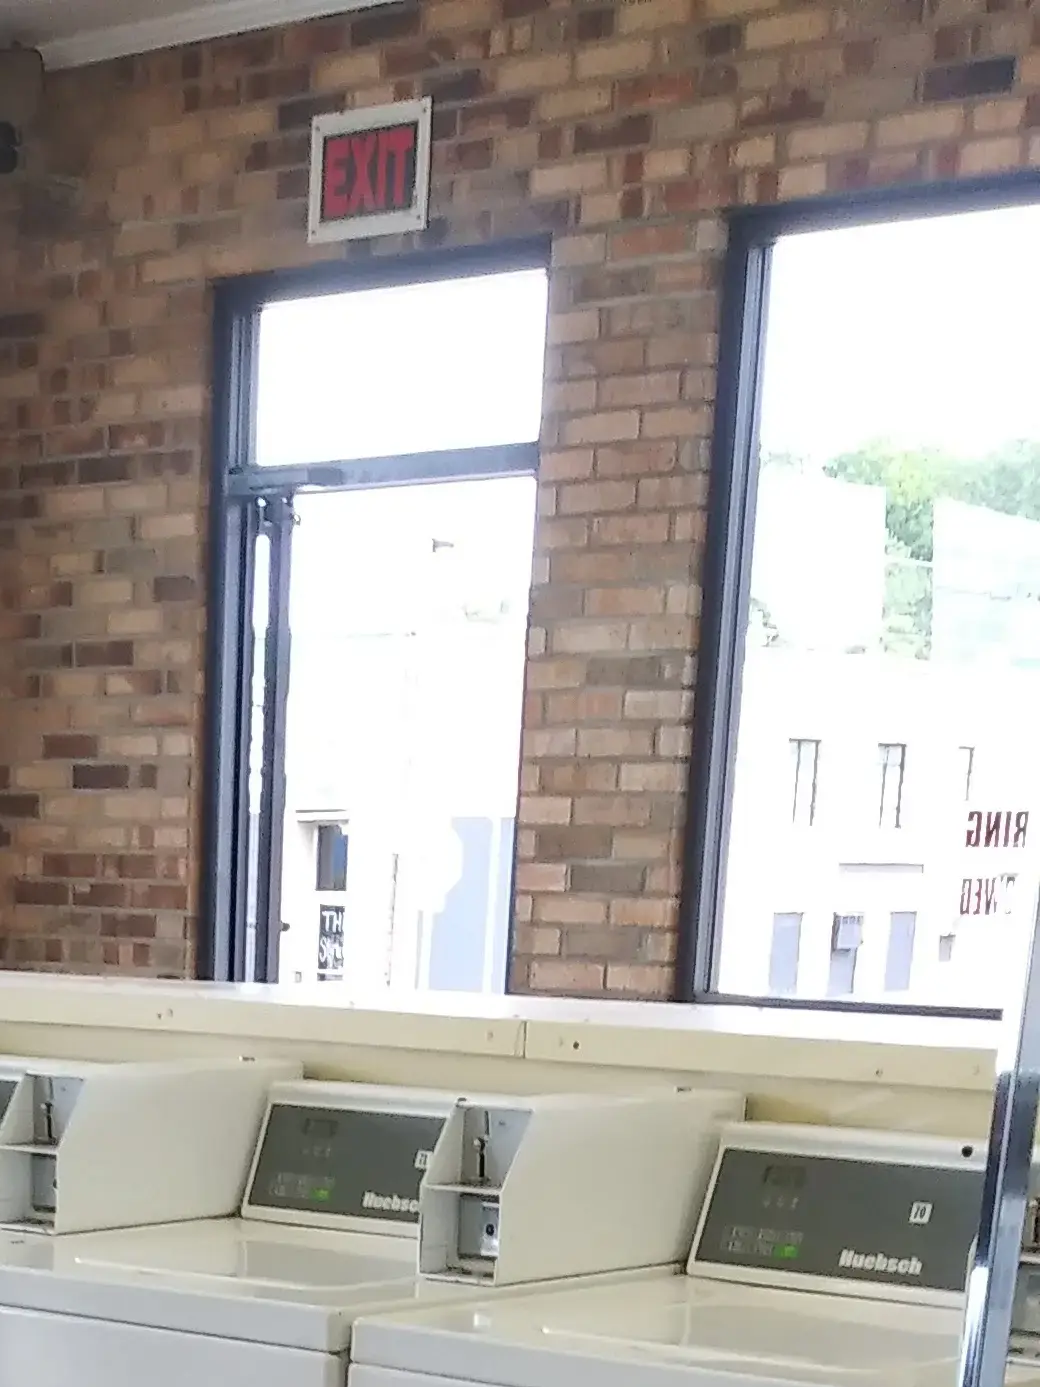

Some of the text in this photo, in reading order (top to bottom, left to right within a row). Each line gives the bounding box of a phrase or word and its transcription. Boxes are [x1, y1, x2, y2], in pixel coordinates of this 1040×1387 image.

[324, 126, 416, 220] EXIT
[362, 1190, 420, 1213] Huebsc
[838, 1247, 923, 1276] Huebsch
